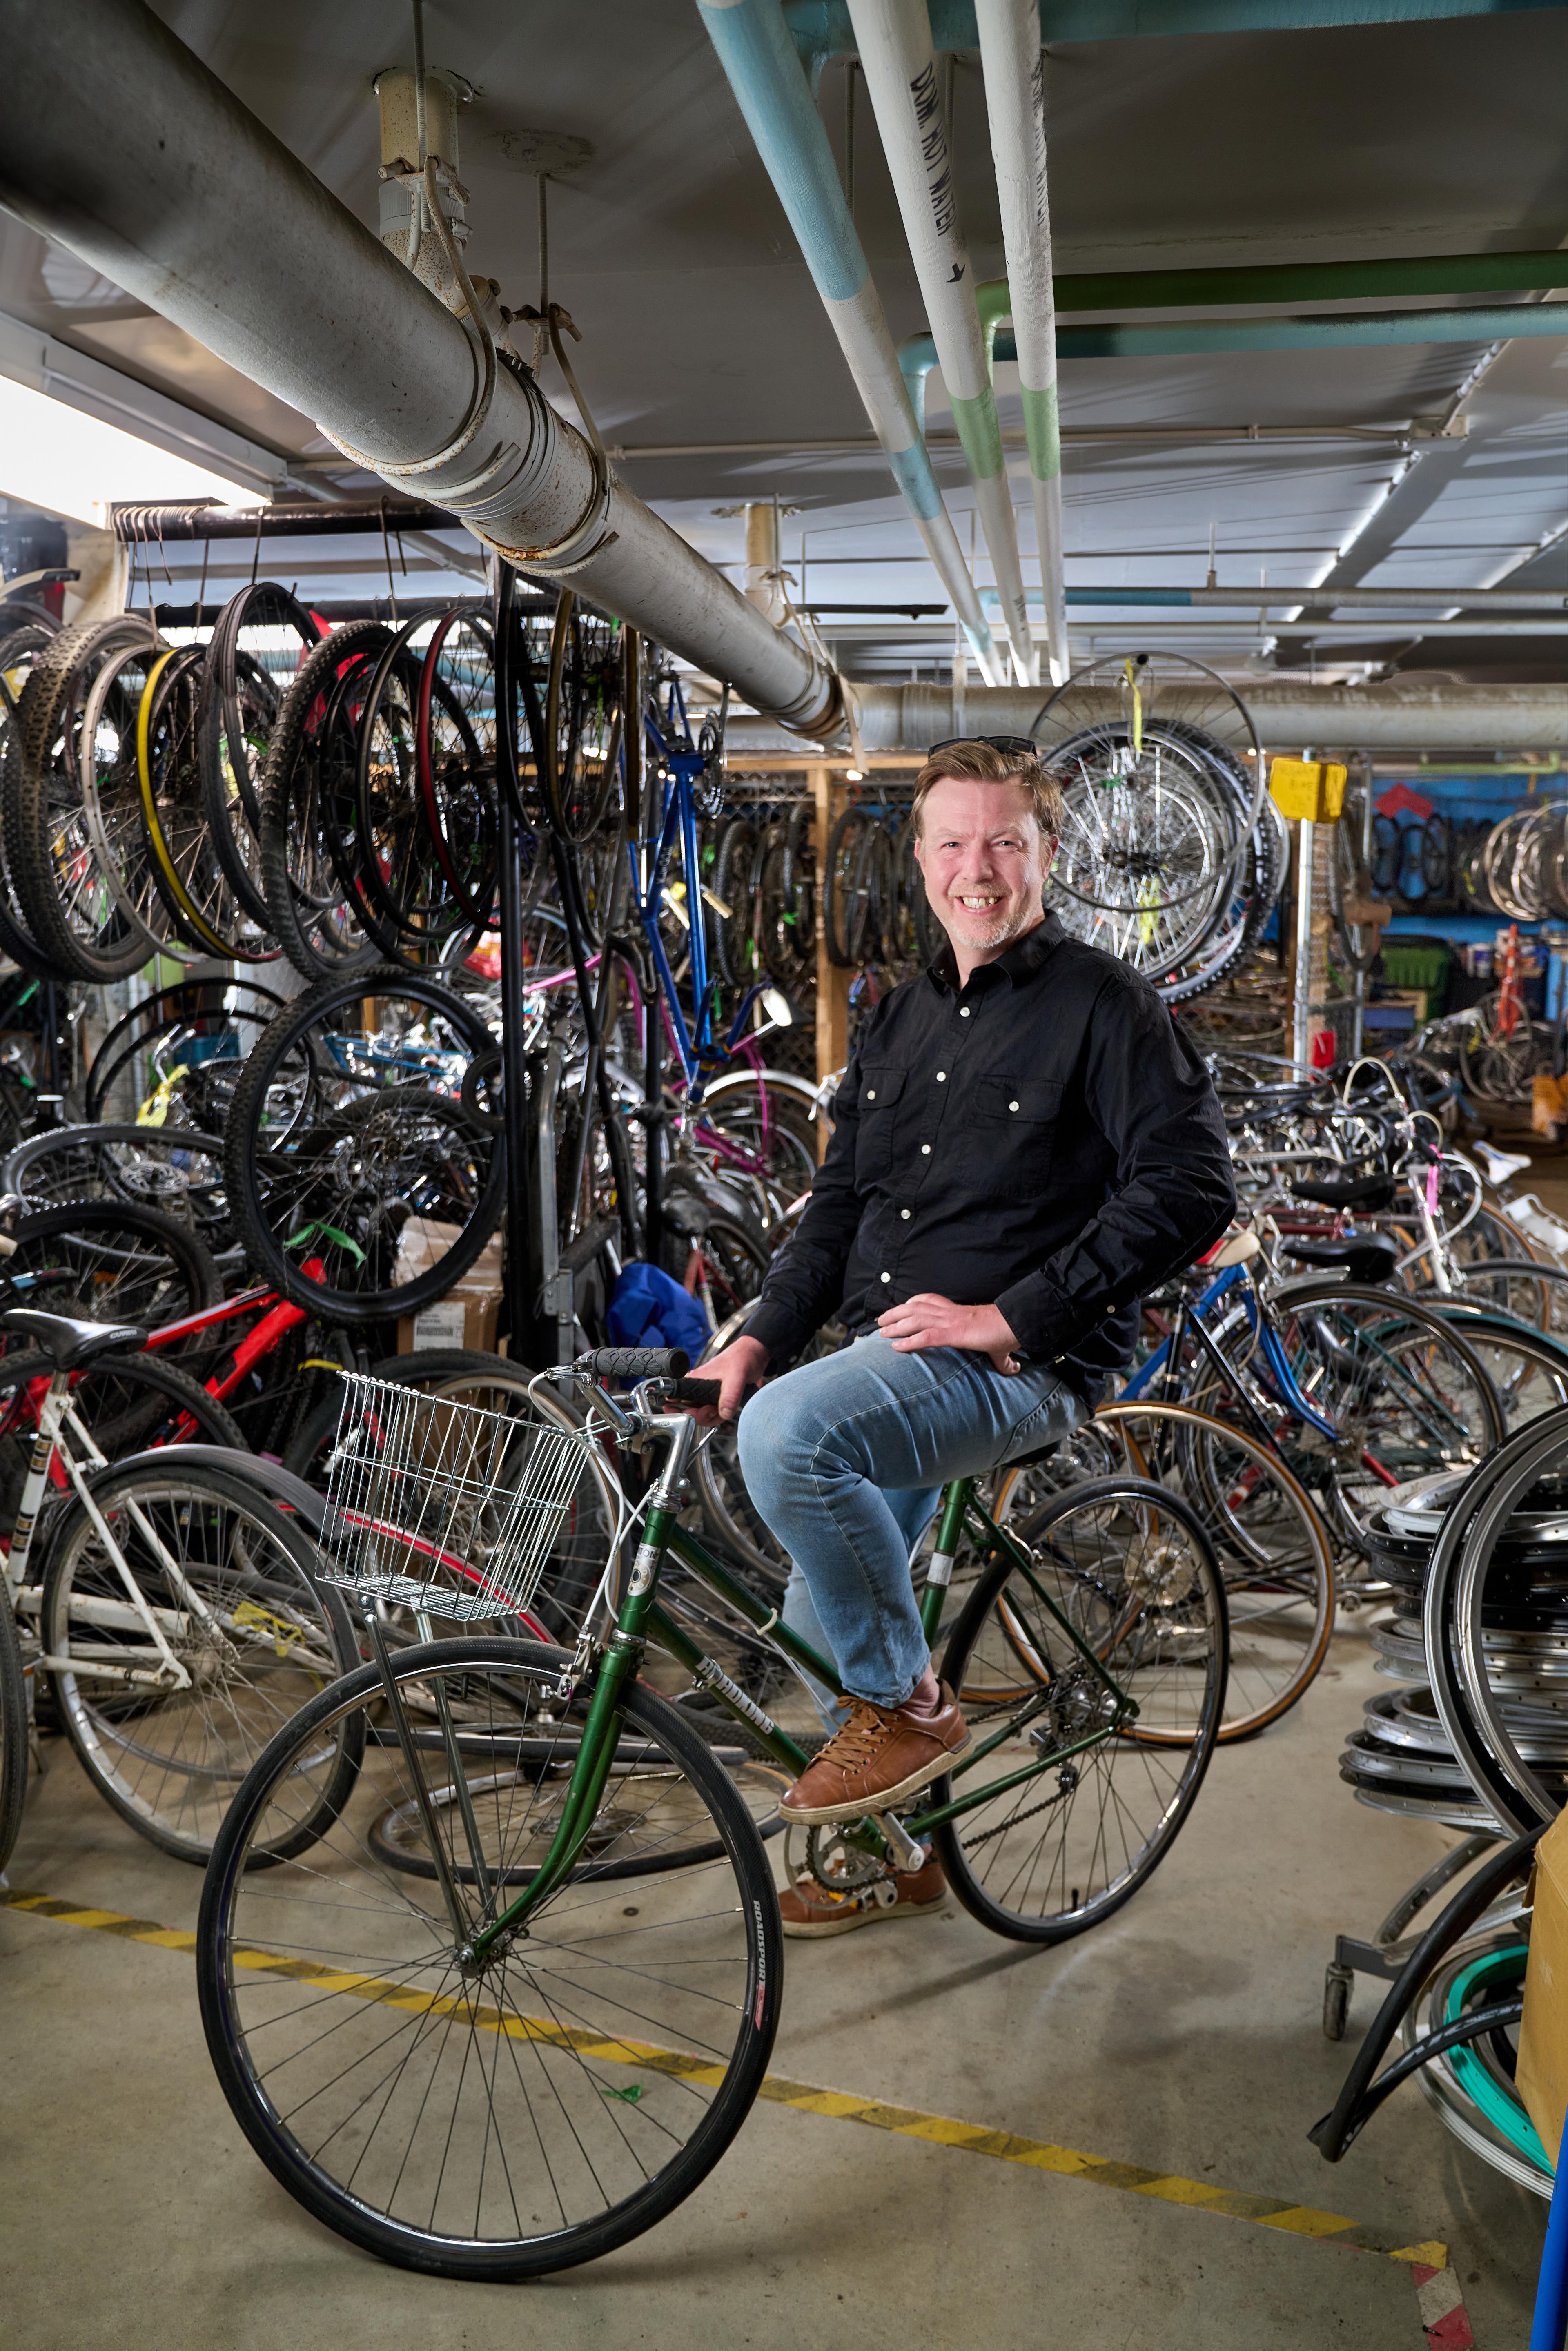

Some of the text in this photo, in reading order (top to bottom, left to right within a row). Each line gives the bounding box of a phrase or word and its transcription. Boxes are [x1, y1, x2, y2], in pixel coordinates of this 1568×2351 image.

[922, 120, 947, 172] HOT
[929, 166, 958, 237] WATER
[753, 1900, 766, 1986] ROADSPORT
